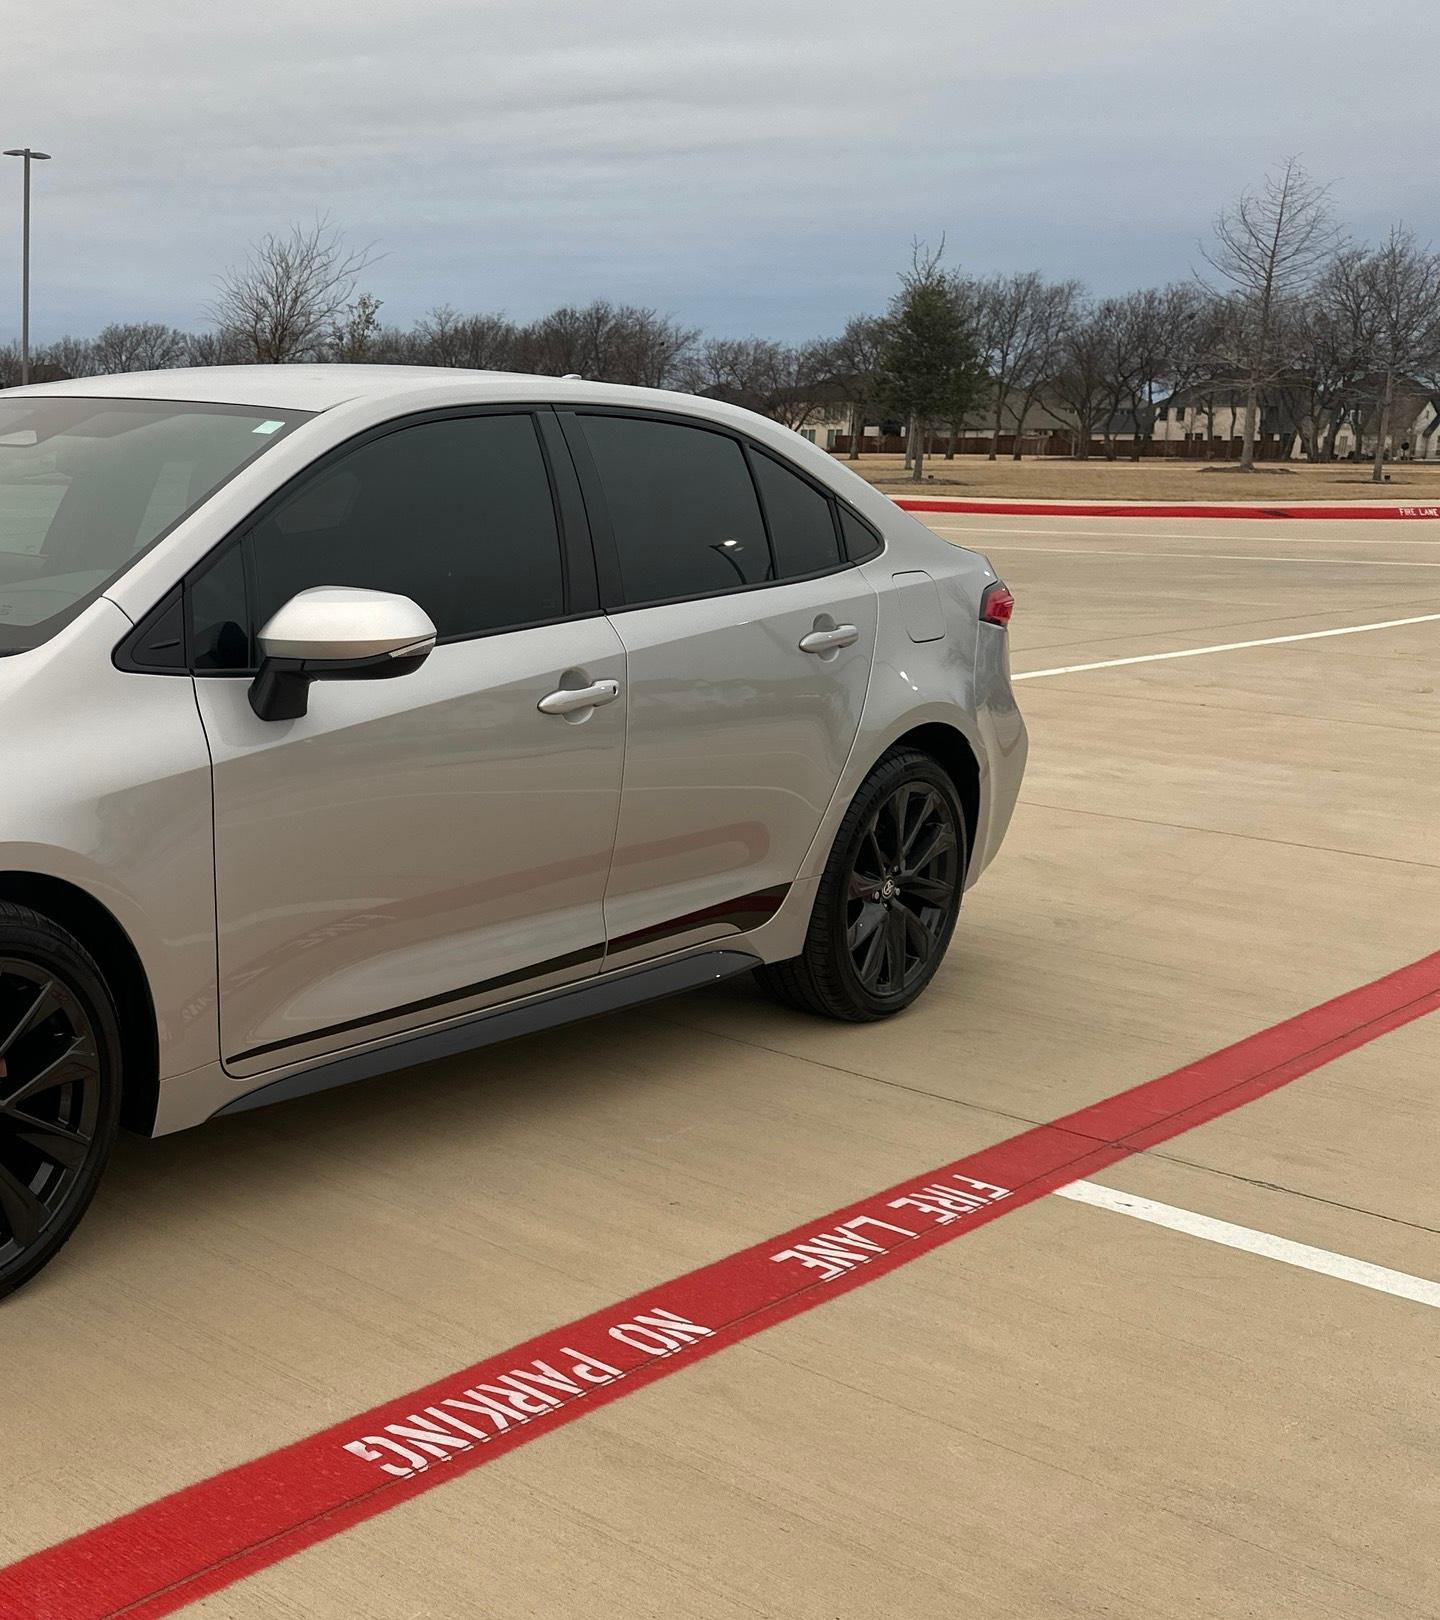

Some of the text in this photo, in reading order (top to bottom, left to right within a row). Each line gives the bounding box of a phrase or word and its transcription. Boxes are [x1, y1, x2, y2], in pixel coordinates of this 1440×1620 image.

[1419, 508, 1439, 517] LANE
[342, 1174, 1014, 1479] FIRE LANE NO PARKING
